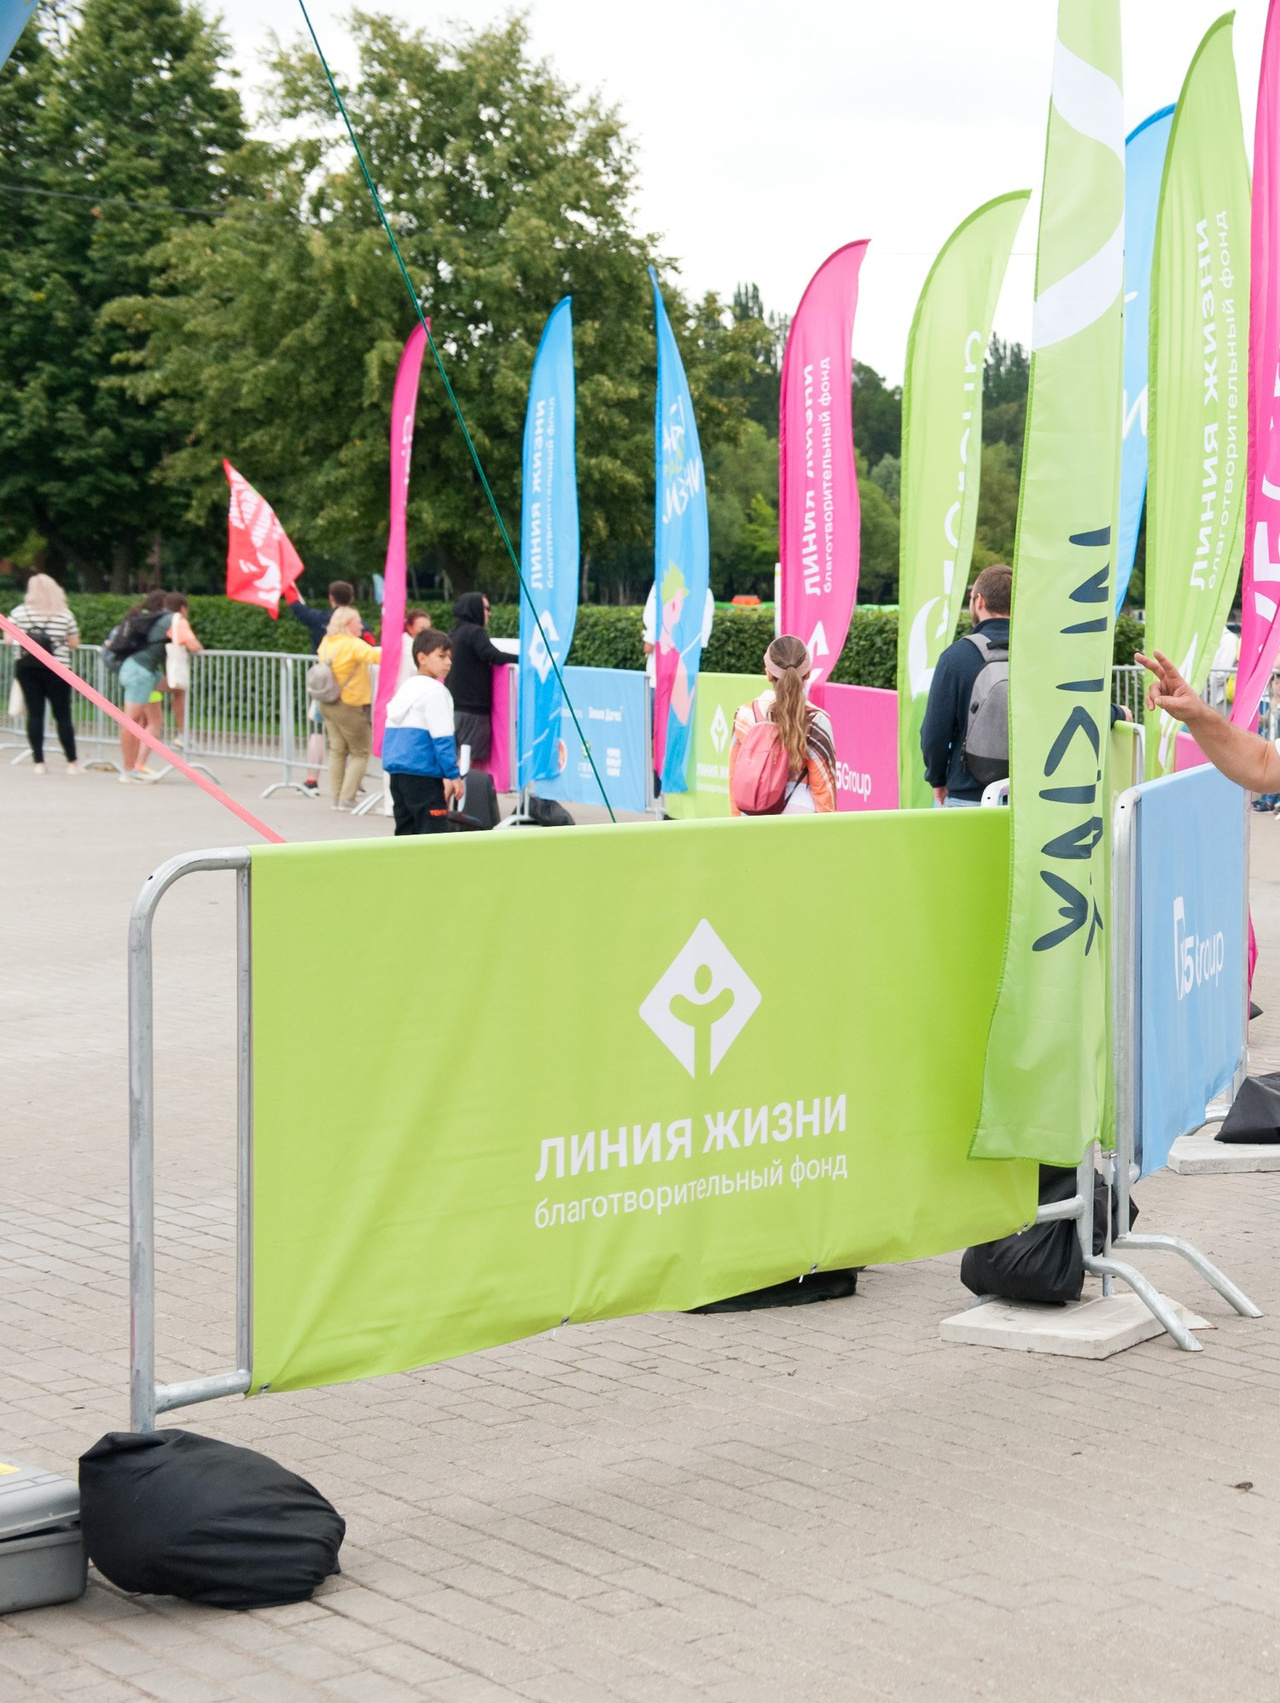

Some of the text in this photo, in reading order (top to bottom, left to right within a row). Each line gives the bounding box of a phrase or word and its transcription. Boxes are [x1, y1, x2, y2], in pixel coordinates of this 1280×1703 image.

[1216, 210, 1235, 290] фонд
[818, 357, 833, 407] фонд
[1190, 219, 1219, 591] ЛИНИЯ ЖИЗНИ
[530, 400, 546, 591] ЛИНИЯ ЖИЗНИ
[836, 761, 872, 802] 5Group
[534, 1094, 847, 1183] ЛИНИЯ ЖИЗНИ
[534, 1154, 848, 1229] благотворительный фонд
